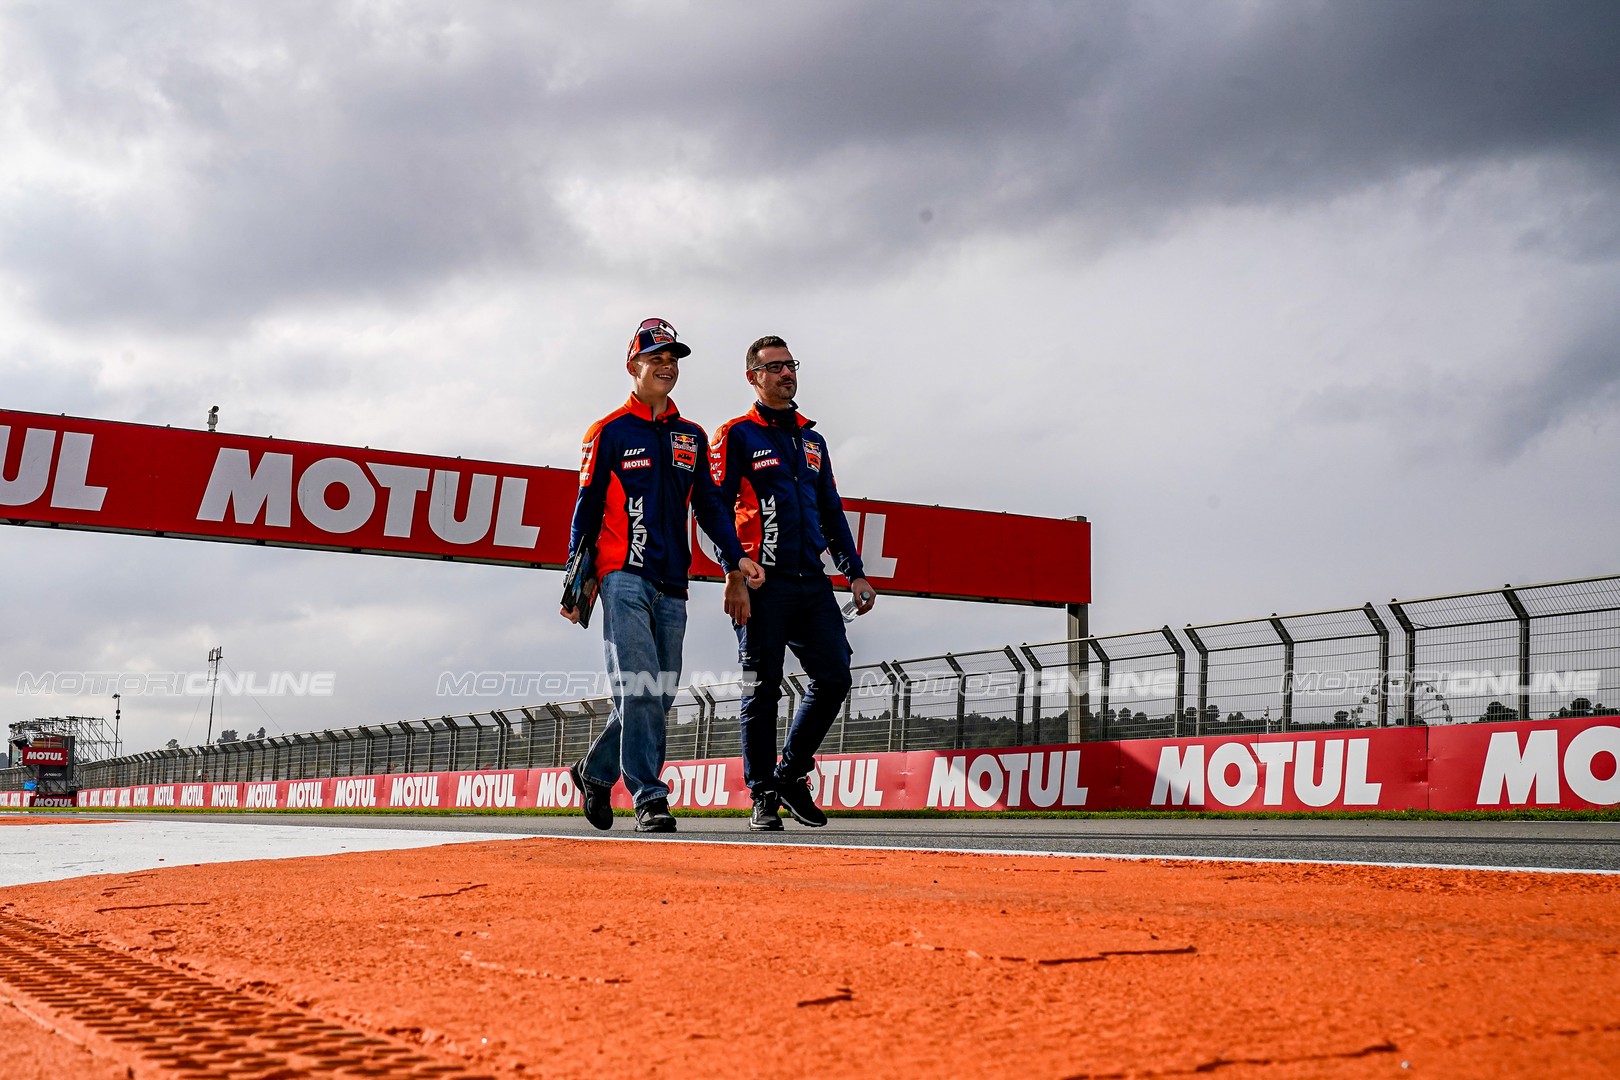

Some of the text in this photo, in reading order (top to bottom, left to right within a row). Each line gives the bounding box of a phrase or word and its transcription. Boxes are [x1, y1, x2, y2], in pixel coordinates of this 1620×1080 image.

[623, 459, 650, 469] MOTUL
[754, 459, 779, 470] MOTUL
[196, 447, 540, 549] MOTUL
[628, 496, 648, 568] RACING
[761, 494, 779, 566] RACING
[26, 751, 63, 761] MOTUL
[659, 763, 729, 807] OTUL
[926, 750, 1088, 807] MOTUL
[1151, 738, 1382, 807] MOTUL
[33, 798, 73, 807] MOTUL
[211, 785, 238, 807] MOTUL
[246, 784, 277, 808] MOTUL
[287, 782, 322, 808] MOTUL
[334, 779, 376, 807] MOTUL
[390, 776, 439, 808] MOTUL
[455, 773, 516, 808] MOTUL
